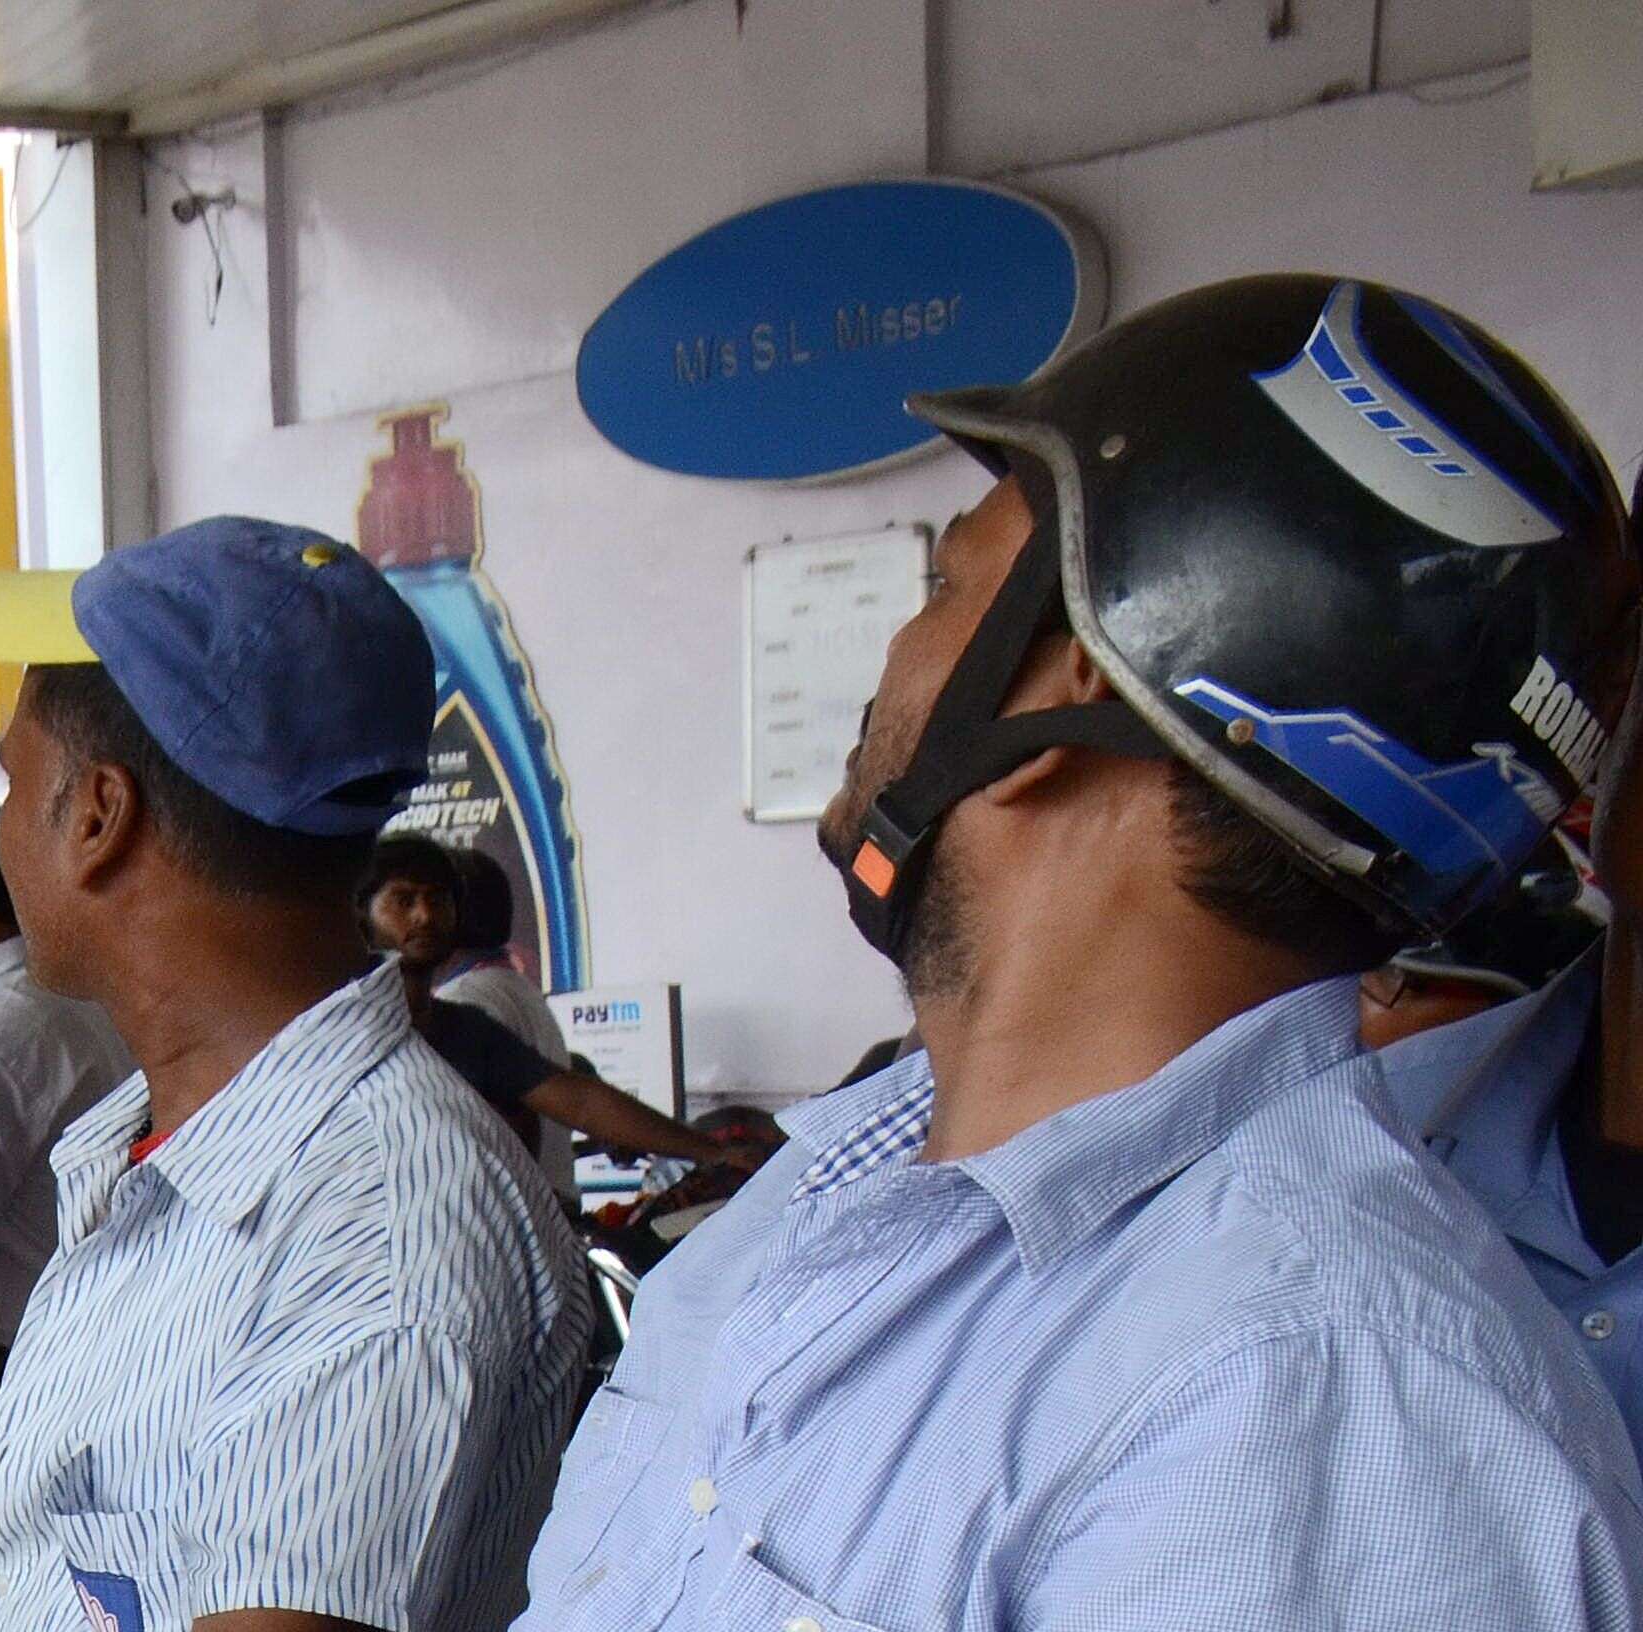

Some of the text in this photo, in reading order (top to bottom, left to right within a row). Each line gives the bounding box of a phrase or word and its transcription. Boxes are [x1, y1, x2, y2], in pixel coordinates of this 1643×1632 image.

[834, 295, 962, 351] Misser
[410, 782, 449, 803] MAK
[572, 1000, 641, 1025] paytm
